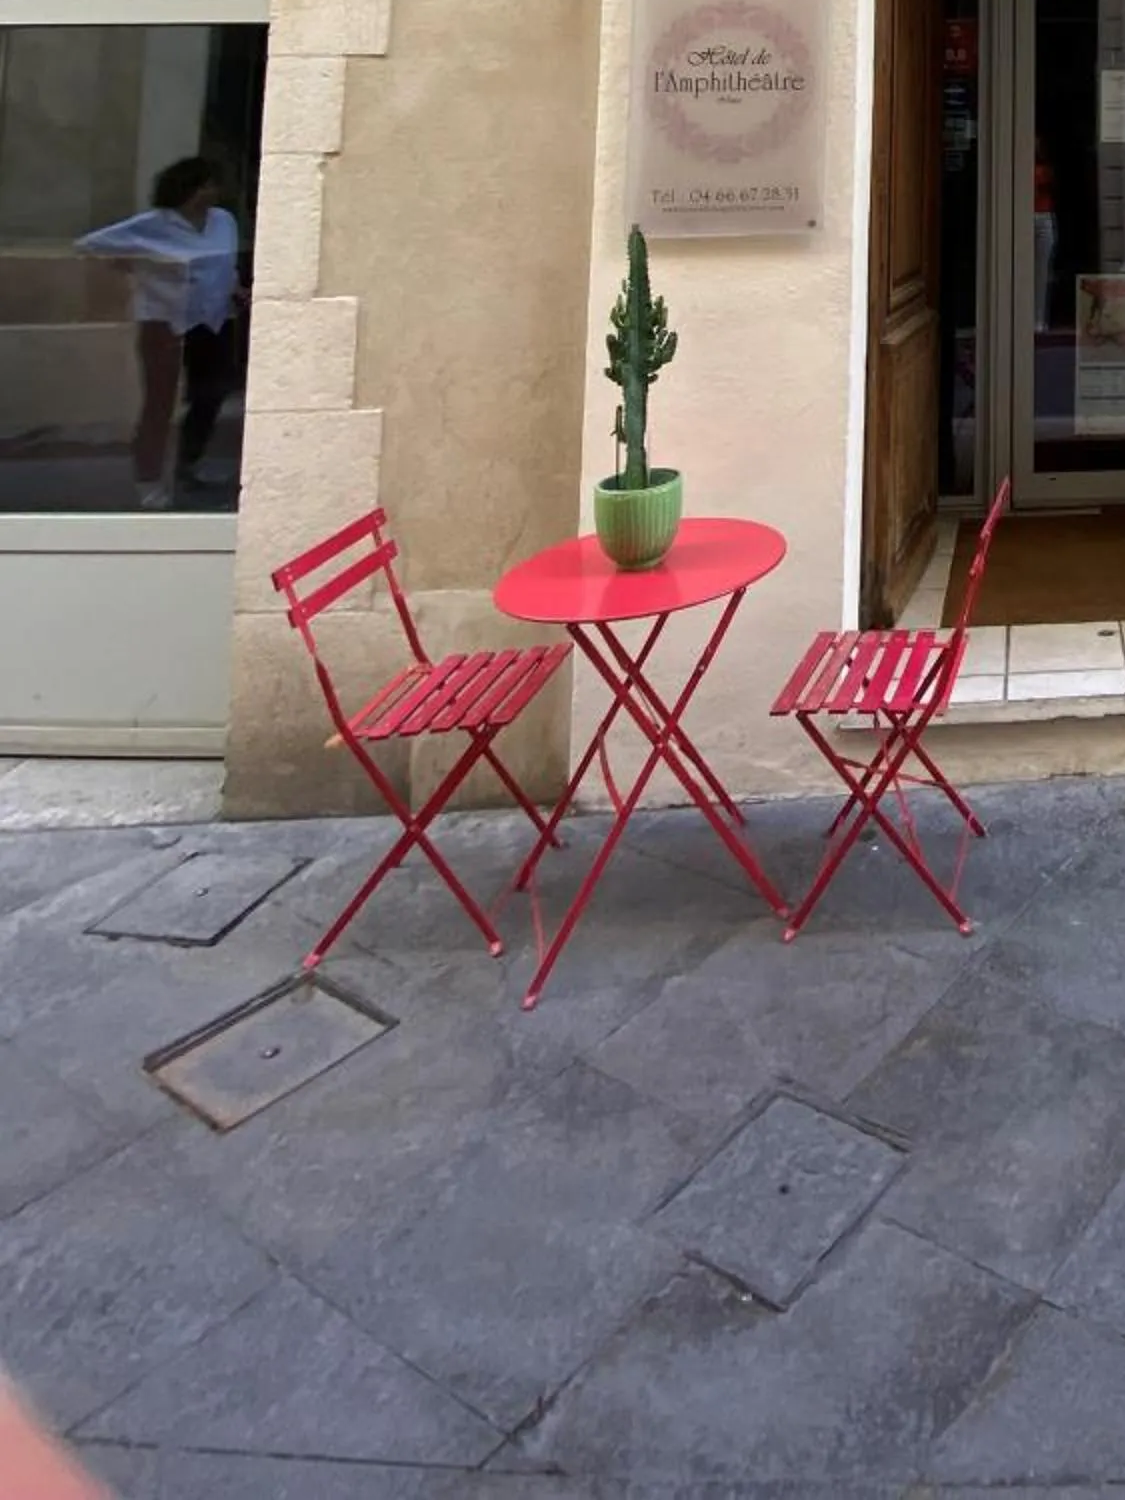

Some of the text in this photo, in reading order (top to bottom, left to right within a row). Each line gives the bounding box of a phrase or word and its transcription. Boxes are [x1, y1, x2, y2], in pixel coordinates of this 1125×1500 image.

[687, 45, 772, 67] Hôtel de
[654, 70, 805, 99] l'Amphithéâtre
